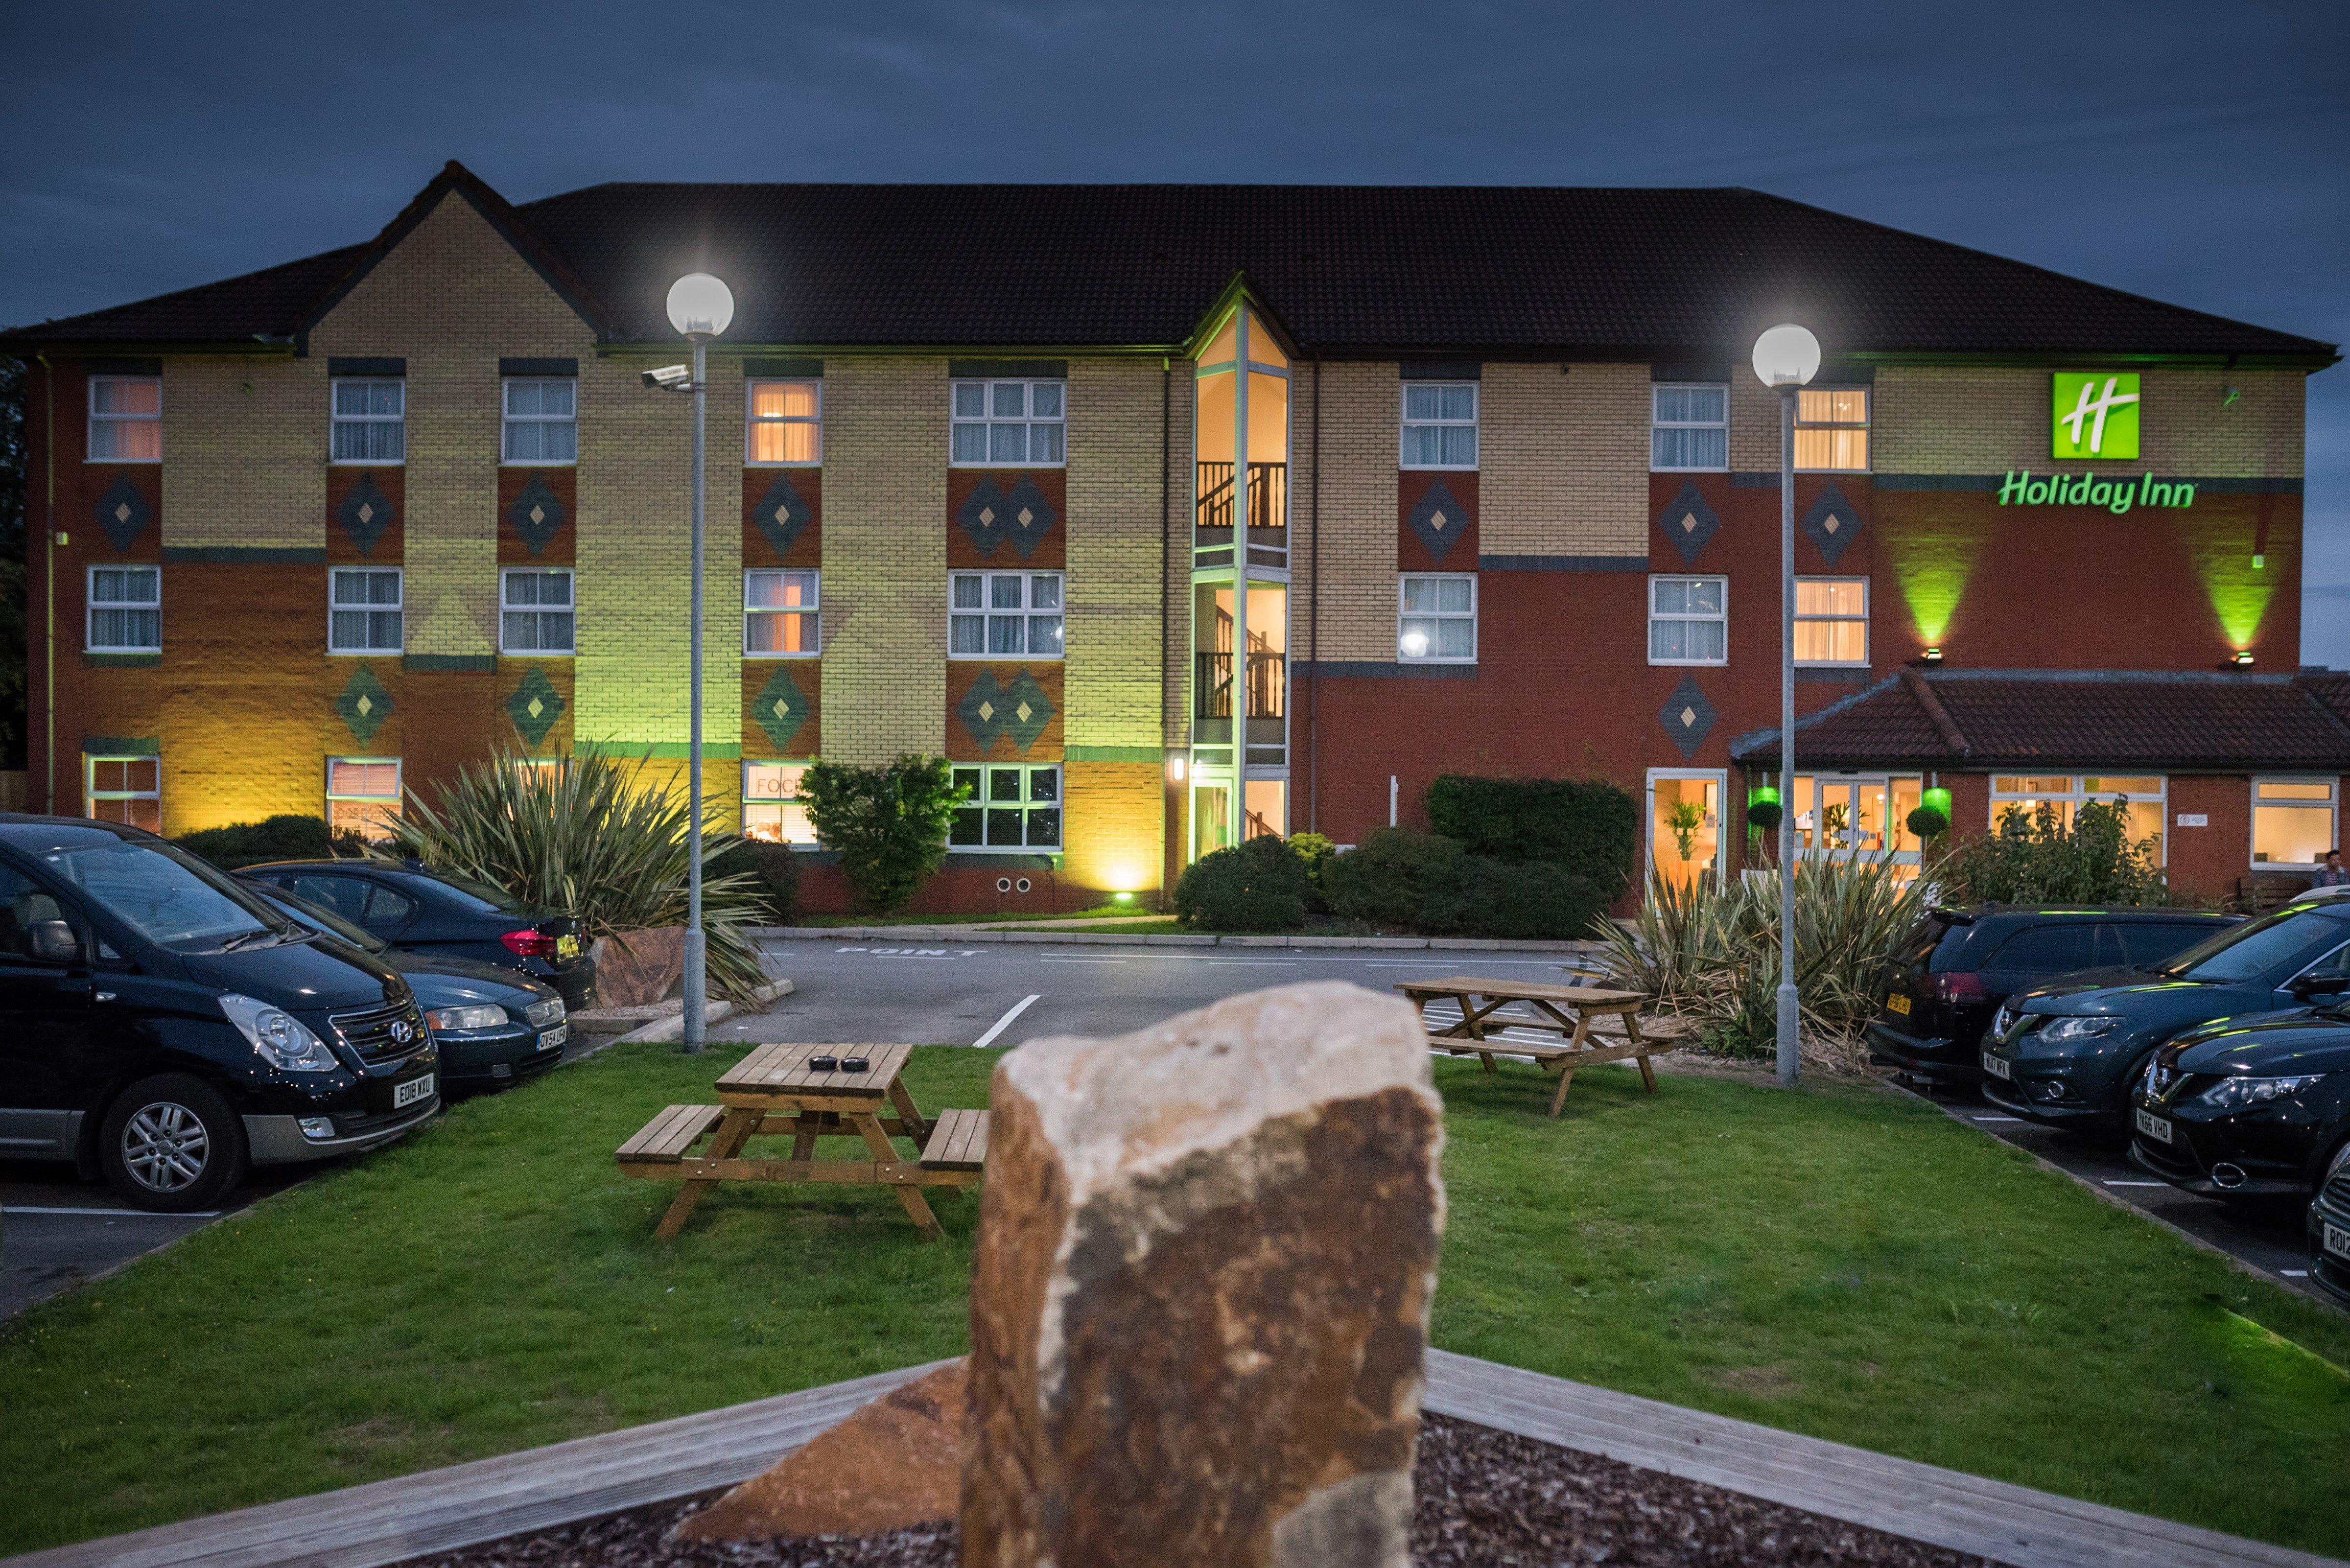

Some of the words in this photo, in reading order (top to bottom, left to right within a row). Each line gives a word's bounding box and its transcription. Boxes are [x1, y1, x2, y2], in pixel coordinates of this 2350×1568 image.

[1998, 470, 2136, 514] Holiday
[2139, 471, 2196, 508] Inn
[835, 947, 988, 956] POINT
[400, 1082, 416, 1103] EO18
[418, 1077, 430, 1096] WXU
[2138, 1112, 2152, 1132] YK66
[2154, 1119, 2168, 1139] VHD
